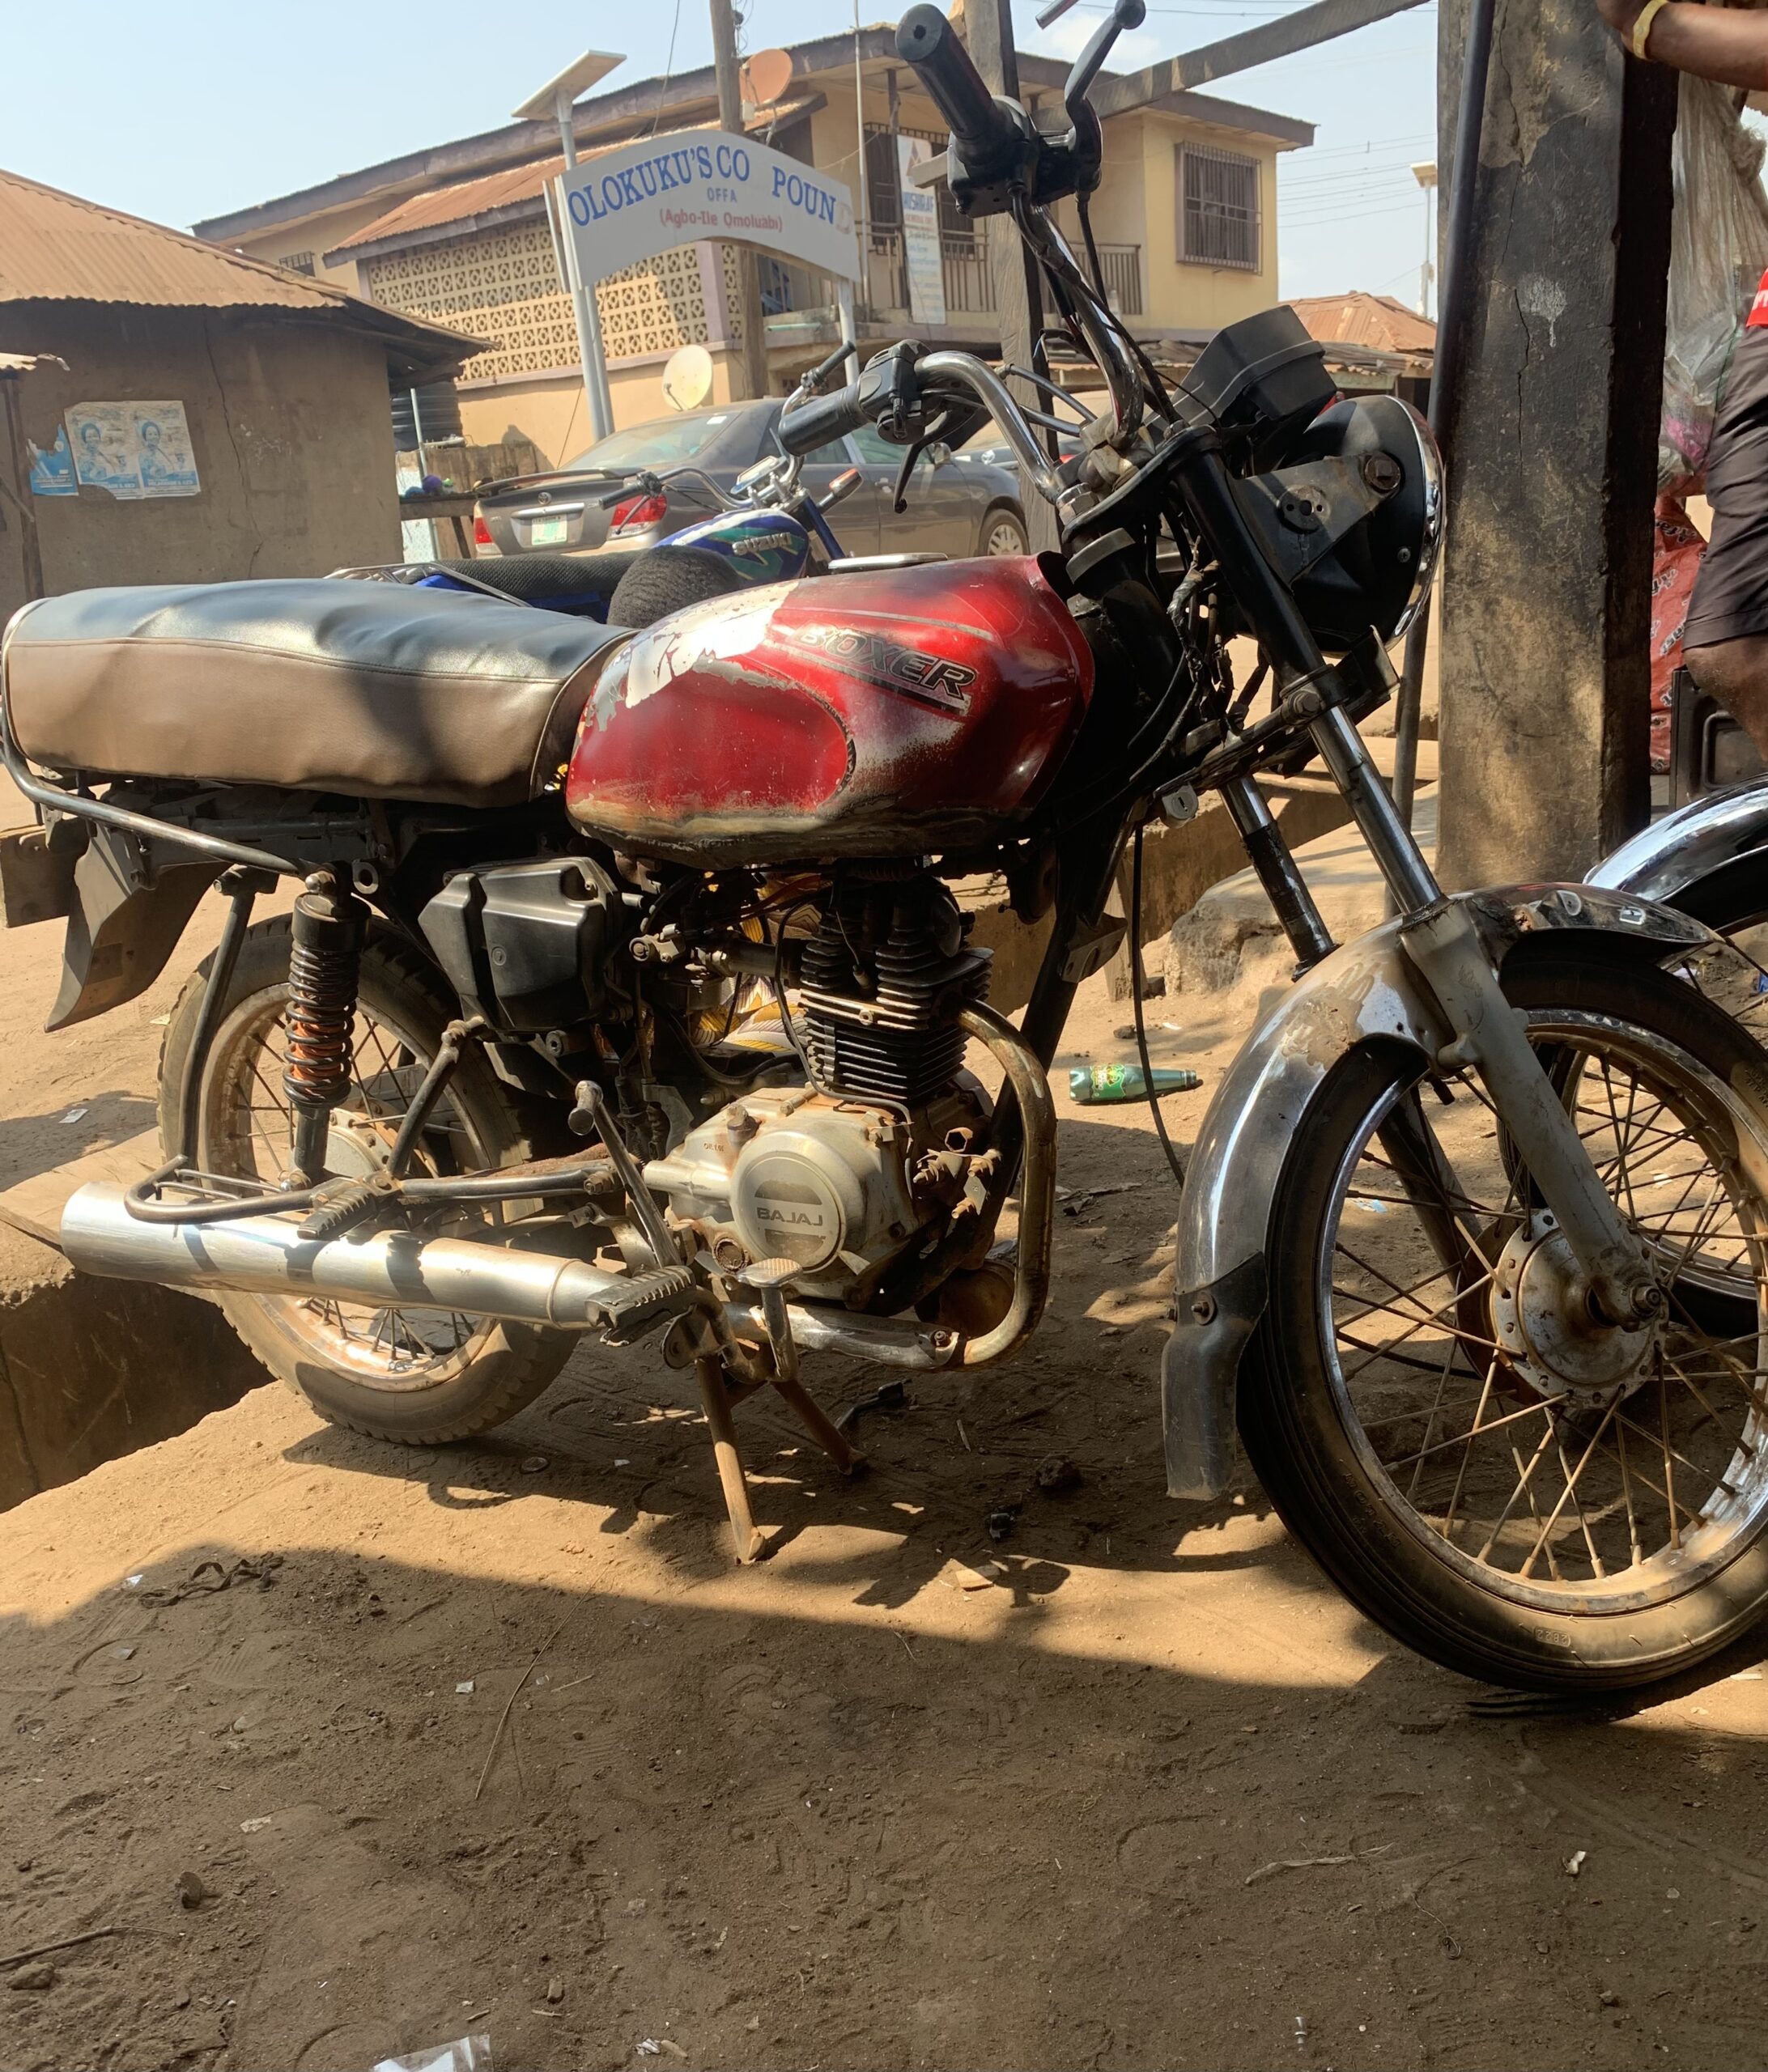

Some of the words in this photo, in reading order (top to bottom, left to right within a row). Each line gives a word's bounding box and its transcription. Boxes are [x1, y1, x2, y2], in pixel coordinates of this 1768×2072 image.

[707, 187, 737, 203] OFFA
[660, 208, 718, 229] (Agbo-Ile
[724, 212, 783, 233] Omoluabi)
[732, 532, 793, 556] SUZUKI
[784, 622, 978, 701] BOXER
[757, 1207, 823, 1226] BAJAJ
[1536, 1629, 1568, 1645] 2822
